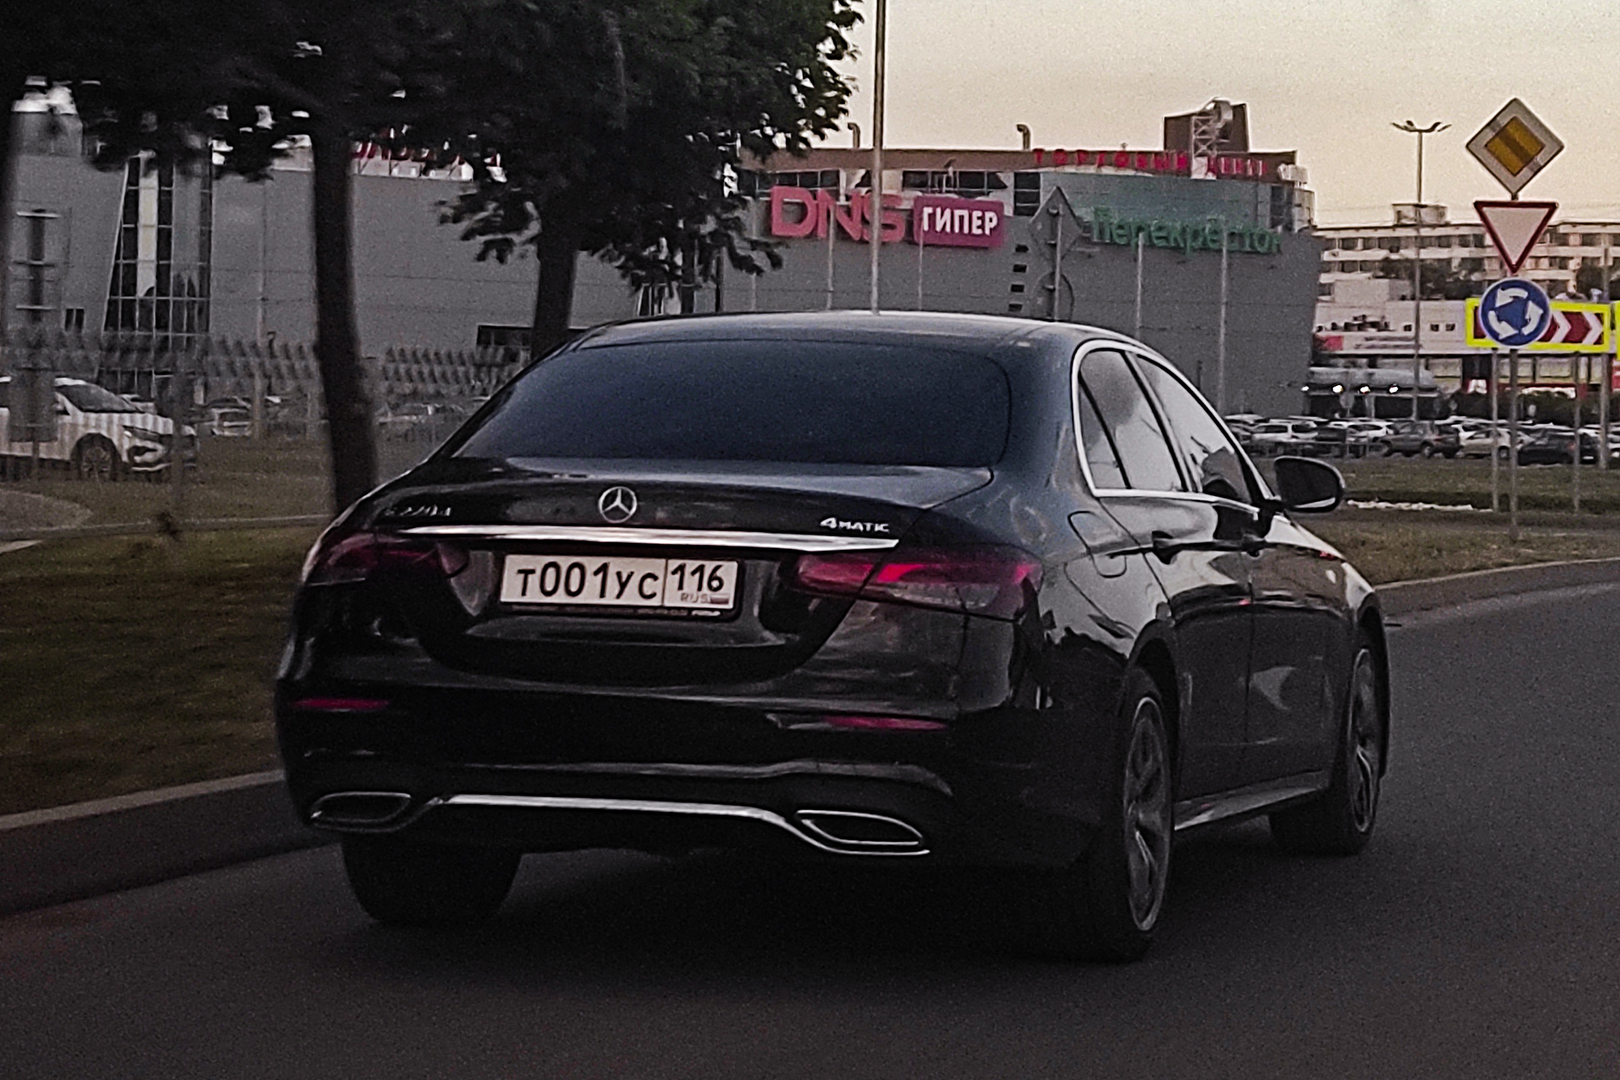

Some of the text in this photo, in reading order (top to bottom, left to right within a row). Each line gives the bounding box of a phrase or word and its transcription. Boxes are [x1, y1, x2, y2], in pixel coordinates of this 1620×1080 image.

[770, 186, 906, 243] DNS
[921, 206, 998, 236] ГИПЕР
[820, 517, 890, 533] 4MATIC
[671, 562, 725, 593] 116
[680, 592, 708, 604] RUS
